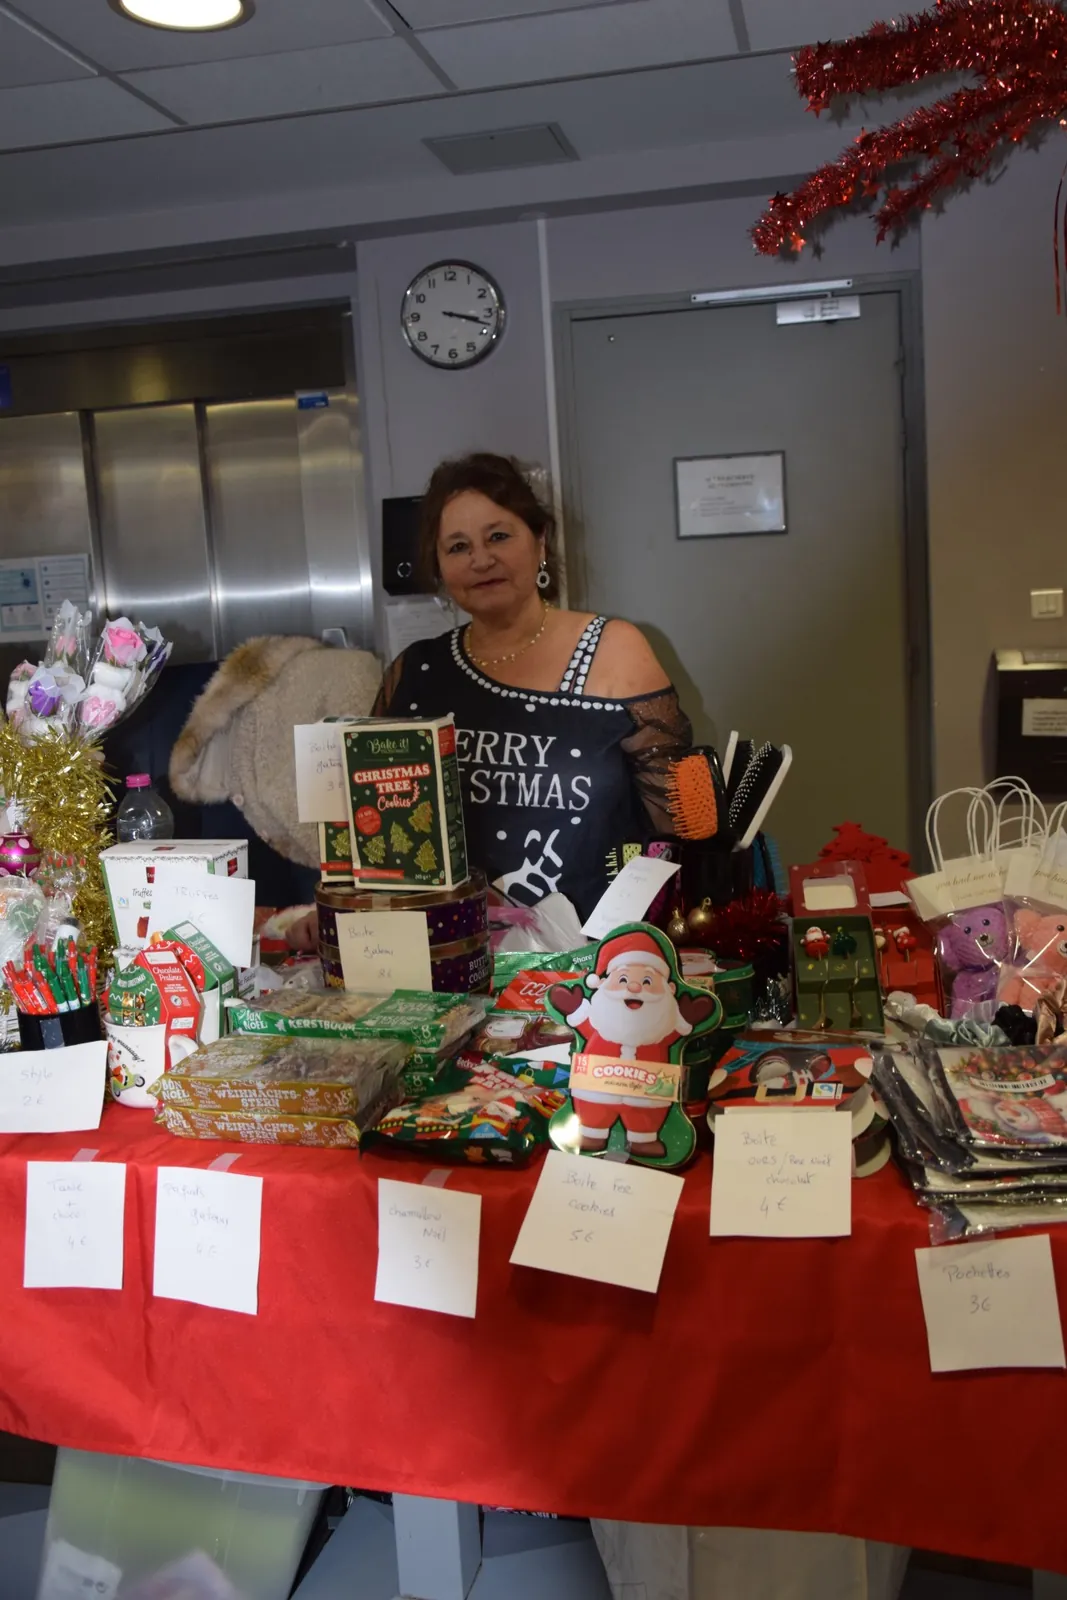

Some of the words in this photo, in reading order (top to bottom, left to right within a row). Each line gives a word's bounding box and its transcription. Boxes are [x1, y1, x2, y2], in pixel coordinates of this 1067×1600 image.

[444, 271, 457, 281] 12
[467, 274, 471, 285] 1
[428, 278, 436, 288] 11
[416, 293, 426, 304] 10
[477, 288, 487, 299] 2
[410, 312, 421, 322] 9
[483, 307, 493, 318] 3
[417, 331, 428, 341] 8
[430, 344, 440, 355] 7
[466, 342, 477, 352] 5
[448, 348, 458, 359] 6
[366, 738, 396, 754] Bake
[353, 763, 431, 784] CHRISTMAS
[375, 779, 412, 794] TREE
[458, 768, 592, 811] STMAS
[377, 794, 412, 811] Cookies
[572, 954, 593, 965] Share
[152, 966, 182, 975] Chocolate
[158, 974, 184, 982] Pralines
[421, 1024, 432, 1039] 8
[577, 1055, 587, 1066] 15
[593, 1064, 657, 1085] COOKIES
[161, 1078, 183, 1090] BON
[412, 1075, 423, 1087] 8
[214, 1088, 301, 1099] WEIHNACHTS-
[240, 1097, 280, 1108] STERN
[214, 1121, 299, 1132] WEIHNACHTS-
